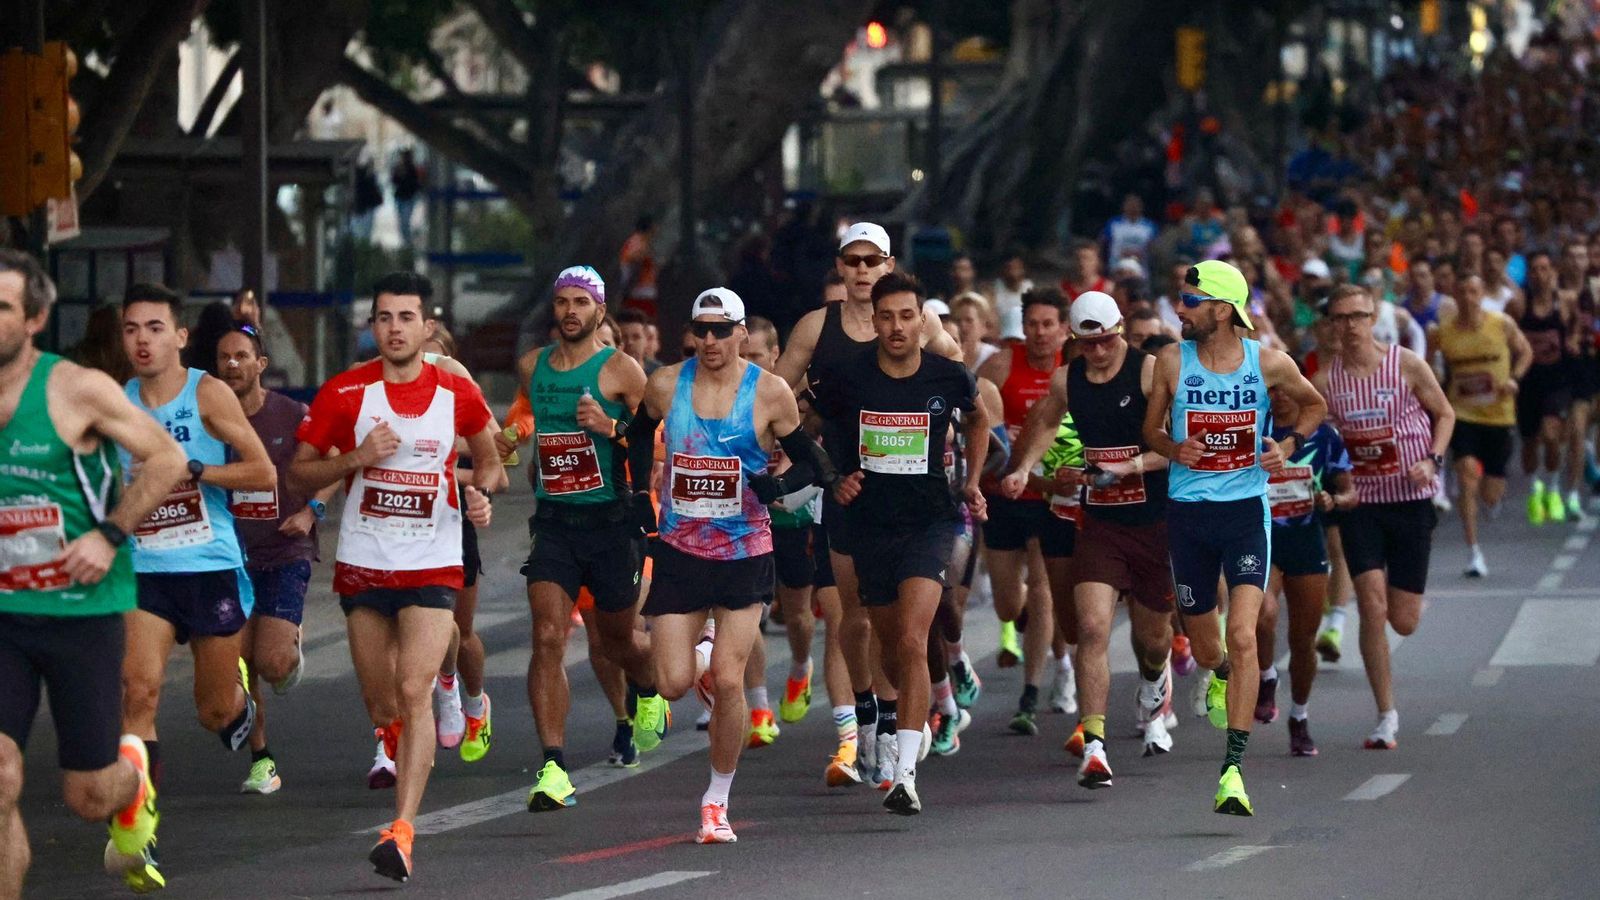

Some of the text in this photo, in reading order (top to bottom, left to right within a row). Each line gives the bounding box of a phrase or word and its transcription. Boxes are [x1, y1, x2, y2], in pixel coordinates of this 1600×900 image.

[1186, 385, 1257, 410] nerja
[878, 416, 924, 426] GENERALI
[1205, 413, 1251, 424] GENERALI
[546, 435, 587, 447] GENERALI
[874, 435, 914, 447] 18057
[1205, 433, 1237, 445] 6251
[549, 454, 579, 468] 3643
[1096, 450, 1138, 461] GENERALI
[689, 459, 735, 471] GENERALI
[383, 470, 434, 484] GENERALI
[685, 478, 725, 491] 17212
[376, 491, 421, 509] 12021
